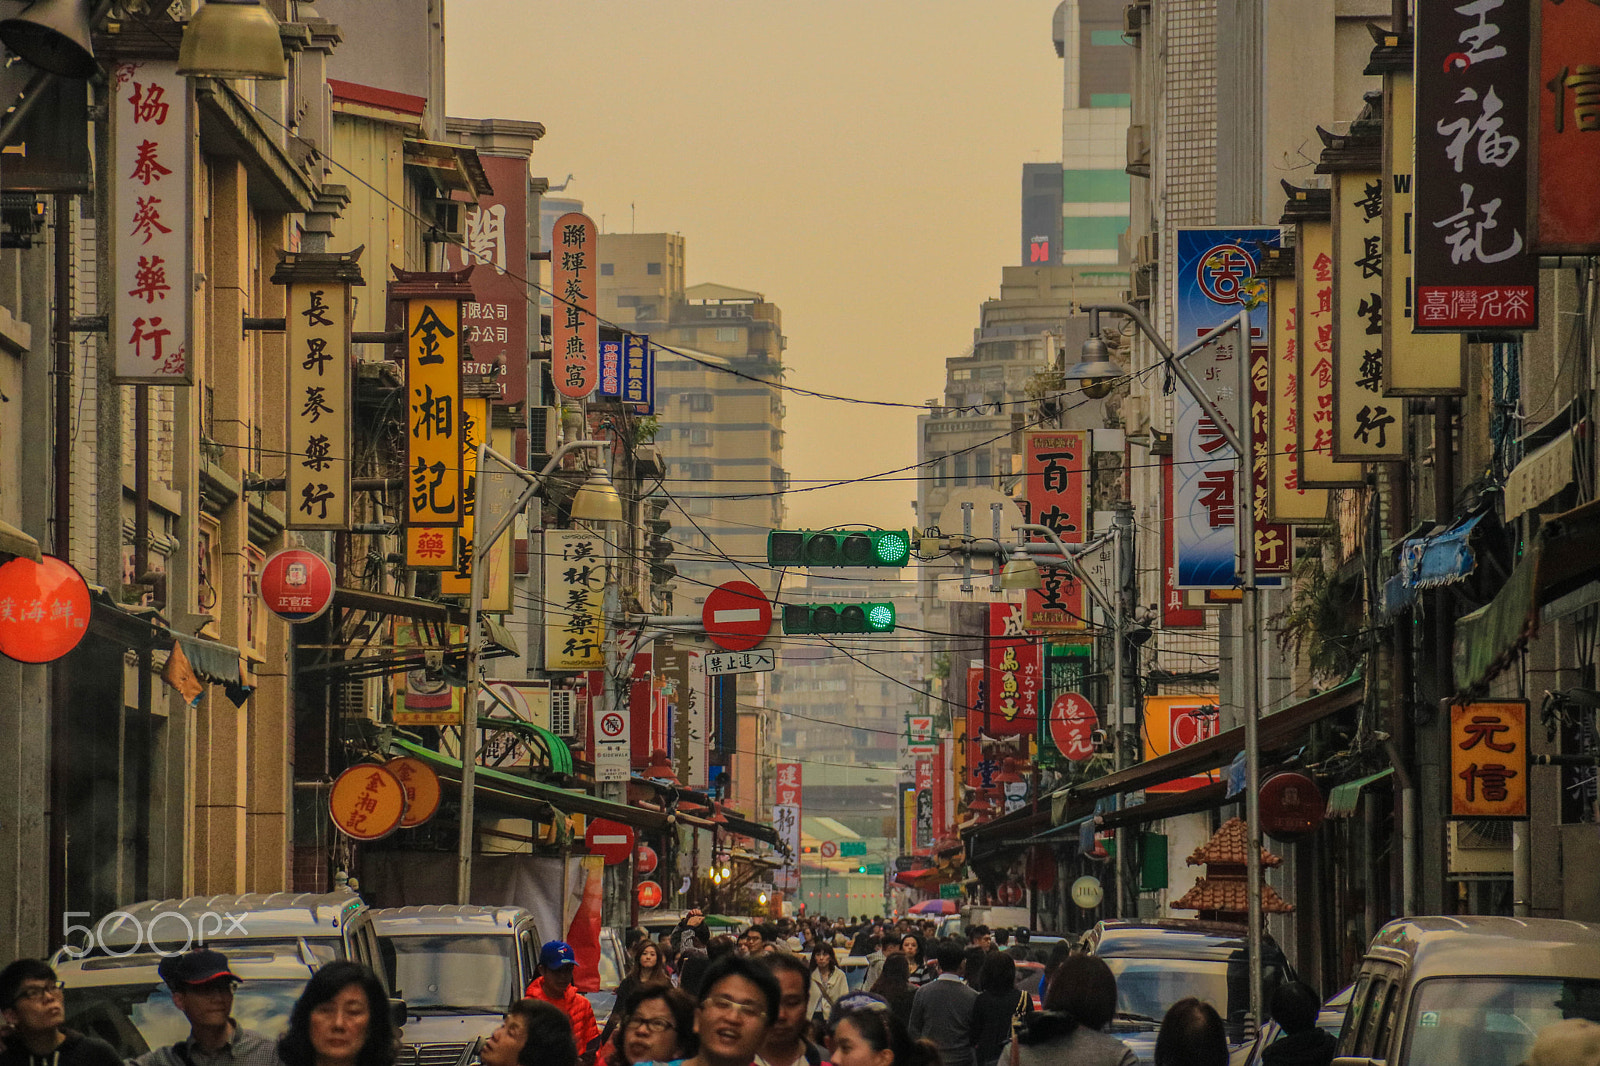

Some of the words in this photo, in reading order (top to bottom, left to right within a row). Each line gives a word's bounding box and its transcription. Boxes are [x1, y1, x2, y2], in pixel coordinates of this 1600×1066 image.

[1432, 0, 1524, 266] 王福記
[463, 326, 508, 344] 分公司
[562, 224, 589, 389] 聯輝蔘茸燕窩
[1423, 289, 1529, 321] 臺灣名茶
[462, 363, 508, 376] 57678
[299, 290, 335, 519] 長昇蔘藥行
[411, 305, 456, 515] 金湘記
[711, 654, 772, 673] 禁止進入
[1000, 646, 1021, 722] 烏魚子
[1023, 662, 1038, 716] からすみ
[1459, 716, 1517, 802] 元信
[346, 772, 387, 833] 金湘記
